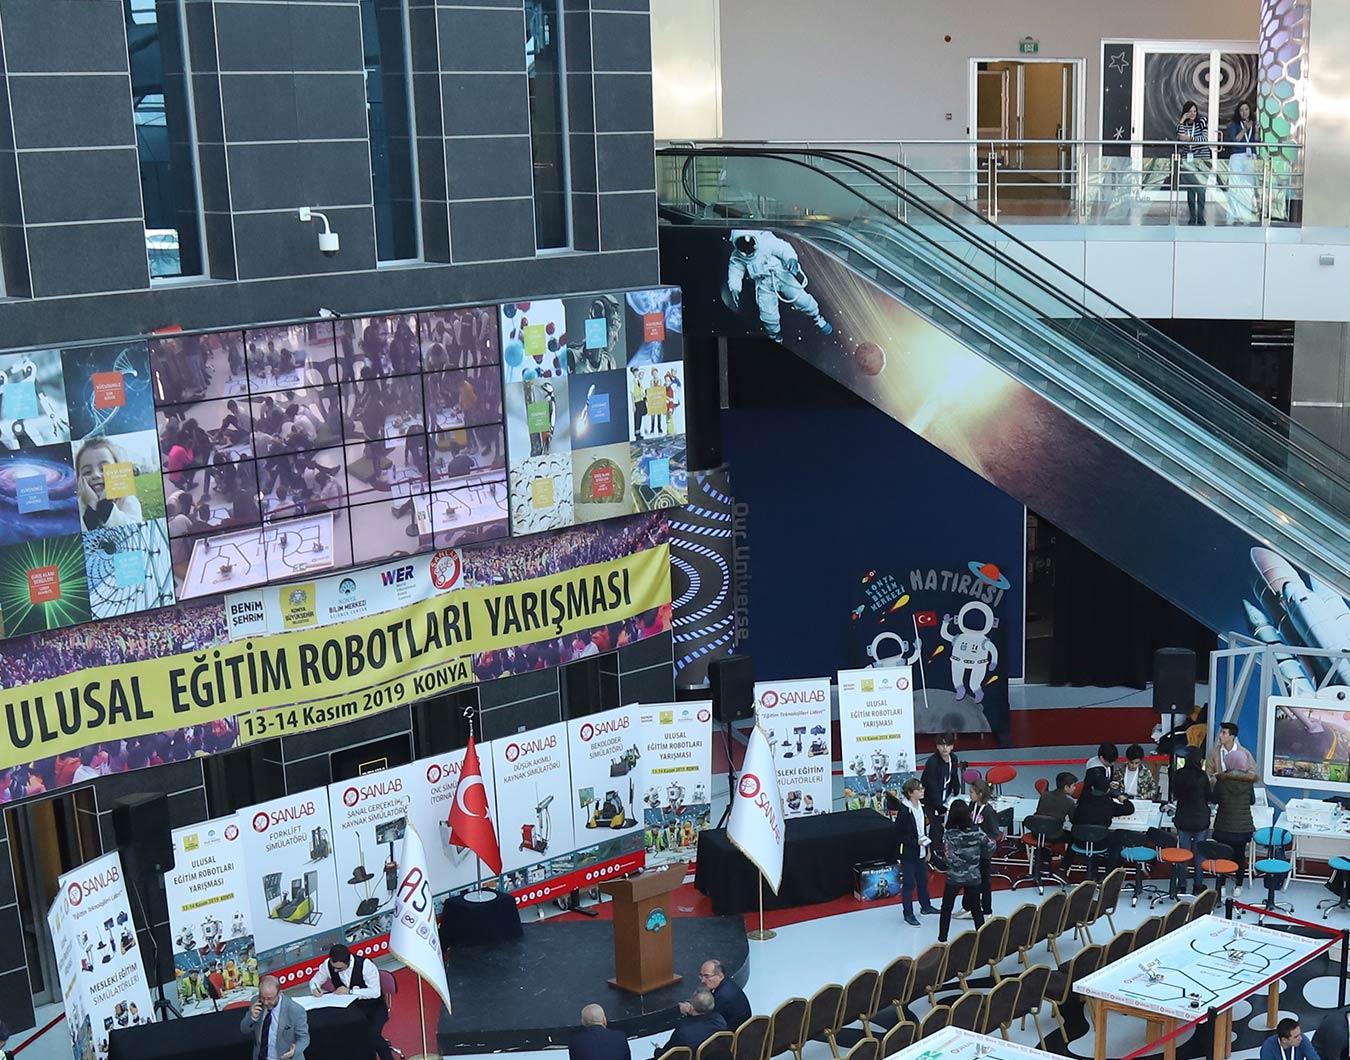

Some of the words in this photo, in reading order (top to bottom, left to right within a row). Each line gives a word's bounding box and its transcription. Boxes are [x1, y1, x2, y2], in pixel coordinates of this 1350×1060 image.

[734, 502, 750, 540] Our
[381, 564, 415, 587] WER
[734, 544, 752, 641] Universe
[865, 574, 895, 597] KONYA
[871, 580, 899, 603] BİLİM
[910, 569, 1004, 607] HATIRASI
[870, 585, 906, 612] MERKEZİ
[231, 601, 264, 616] BENİM
[232, 612, 265, 627] ŞEHRİM
[6, 676, 154, 749] ULUSAL
[169, 641, 288, 713] EĞİTİM
[300, 601, 472, 687] ROBOTLARI
[486, 572, 632, 637] YARIŞMASI
[244, 713, 299, 737] 13-14
[303, 701, 358, 726] Kasım
[362, 683, 405, 710] 2019
[413, 665, 468, 694] KONYA
[780, 689, 826, 705] SANLAB
[866, 699, 888, 707] ULUSAL
[850, 709, 870, 720] EĞİTİM
[871, 708, 903, 717] ROBOTLARI
[594, 716, 630, 736] SANLAB
[863, 719, 893, 729] YARIŞMASI
[590, 737, 621, 750] BEKOLODER
[664, 732, 687, 740] ULUSAL
[669, 740, 703, 749] ROBOTLARI
[521, 734, 557, 757] SANLAB
[513, 761, 532, 772] DÜŞÜK
[532, 755, 551, 767] AKIMLI
[659, 751, 691, 761] YARIŞMASI
[442, 760, 464, 778] SAN
[503, 771, 526, 783] KAYNAK
[527, 761, 560, 778] SİMÜLATÖRÜ
[776, 767, 797, 777] SLEKİ
[798, 764, 824, 776] EĞİTİM
[360, 778, 403, 801] SANLAB
[777, 775, 823, 787] MÜLATÖRLERİ
[270, 800, 316, 825] SANLAB
[347, 807, 367, 819] SANAL
[269, 824, 302, 841] FORKLİFT
[342, 817, 367, 830] KAYNAK
[265, 832, 308, 853] SİMÜLATÖRÜ
[191, 855, 217, 869] ULUSAL
[82, 866, 120, 898] SANLAB
[173, 871, 198, 885] EĞİTİM
[198, 862, 235, 879] ROBOTLARI
[188, 877, 225, 894] YARIŞMASI
[89, 973, 118, 995] MESLEKİ
[118, 962, 138, 982] EĞİTİM
